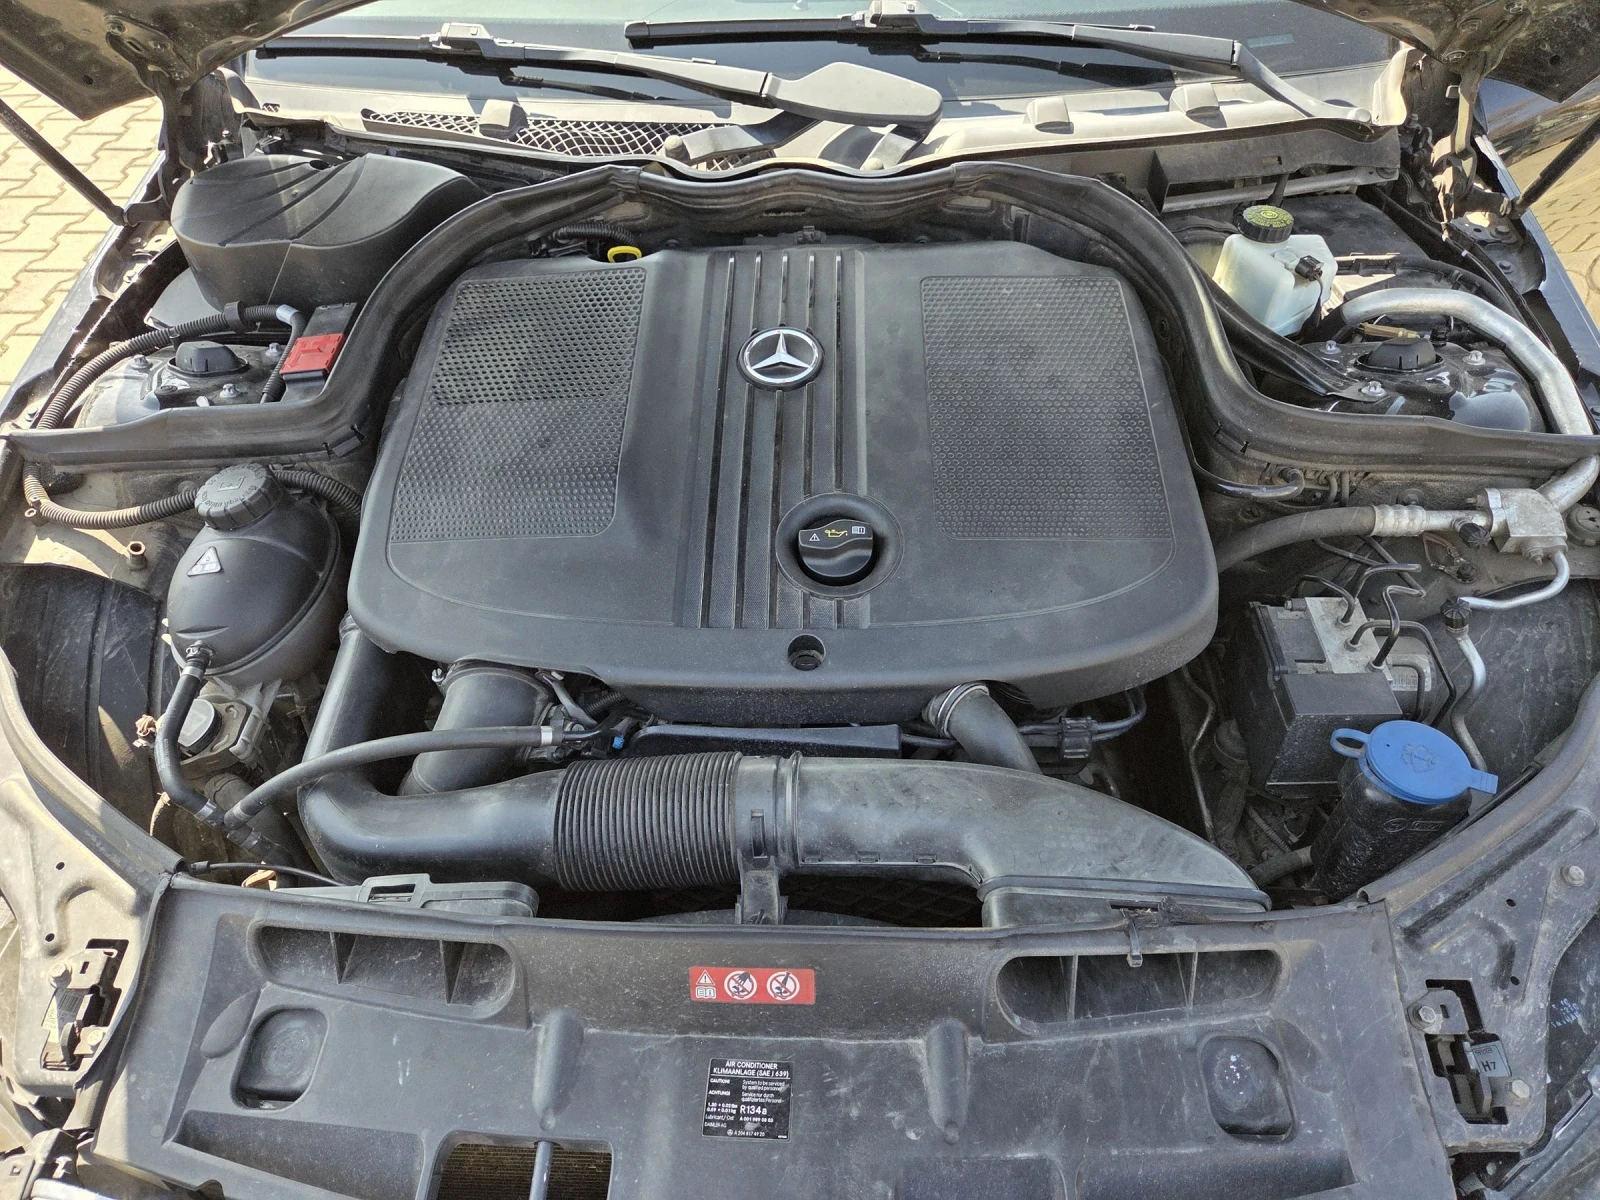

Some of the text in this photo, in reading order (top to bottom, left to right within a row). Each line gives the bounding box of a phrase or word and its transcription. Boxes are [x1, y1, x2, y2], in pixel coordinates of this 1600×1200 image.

[725, 1060, 778, 1069] AIR CONDITIONER
[713, 1067, 755, 1076] KLIMAANLAGE
[775, 1070, 789, 1078] 639)
